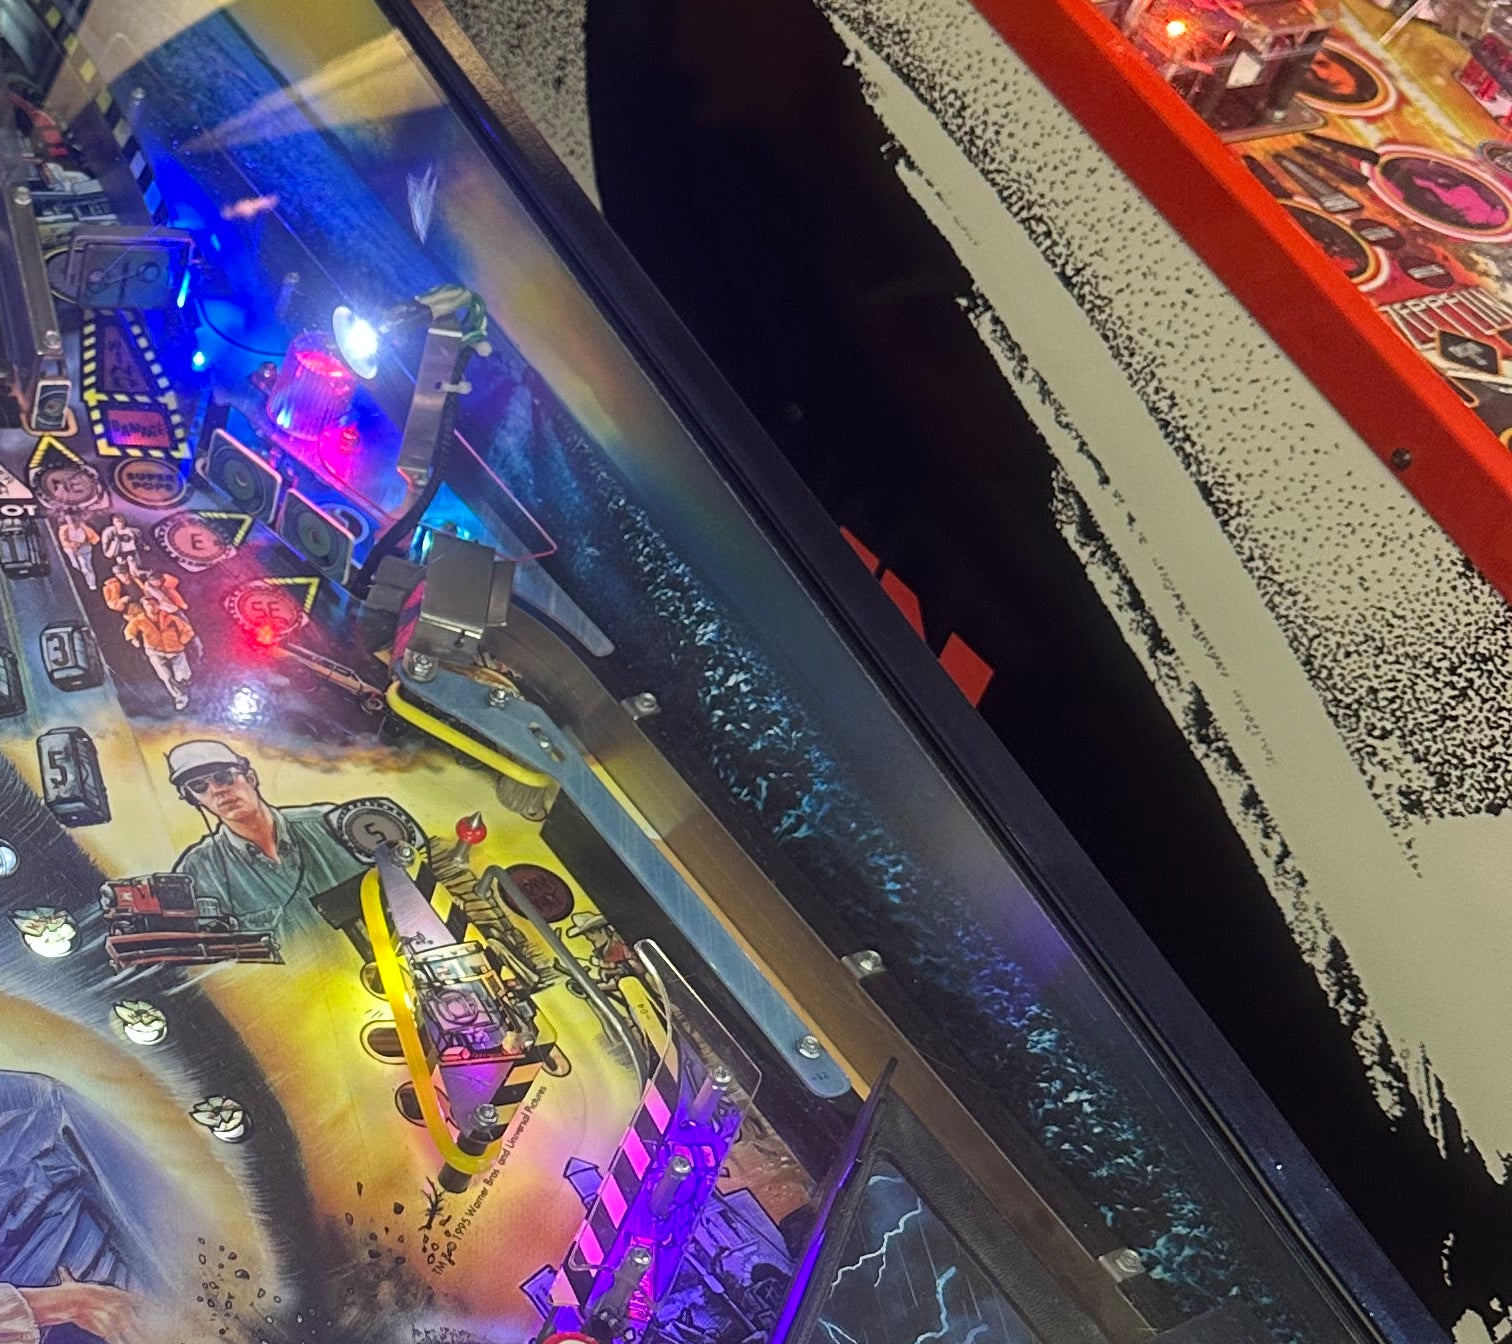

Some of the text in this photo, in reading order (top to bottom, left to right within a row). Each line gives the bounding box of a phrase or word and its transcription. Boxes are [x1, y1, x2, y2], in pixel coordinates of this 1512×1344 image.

[190, 532, 204, 551] E
[45, 632, 69, 667] 3
[47, 750, 69, 790] 5
[453, 1217, 472, 1241] 1995
[465, 1186, 489, 1218] Warner
[498, 1149, 511, 1166] and
[506, 1111, 531, 1149] Universal
[529, 1086, 547, 1113] Pictures
